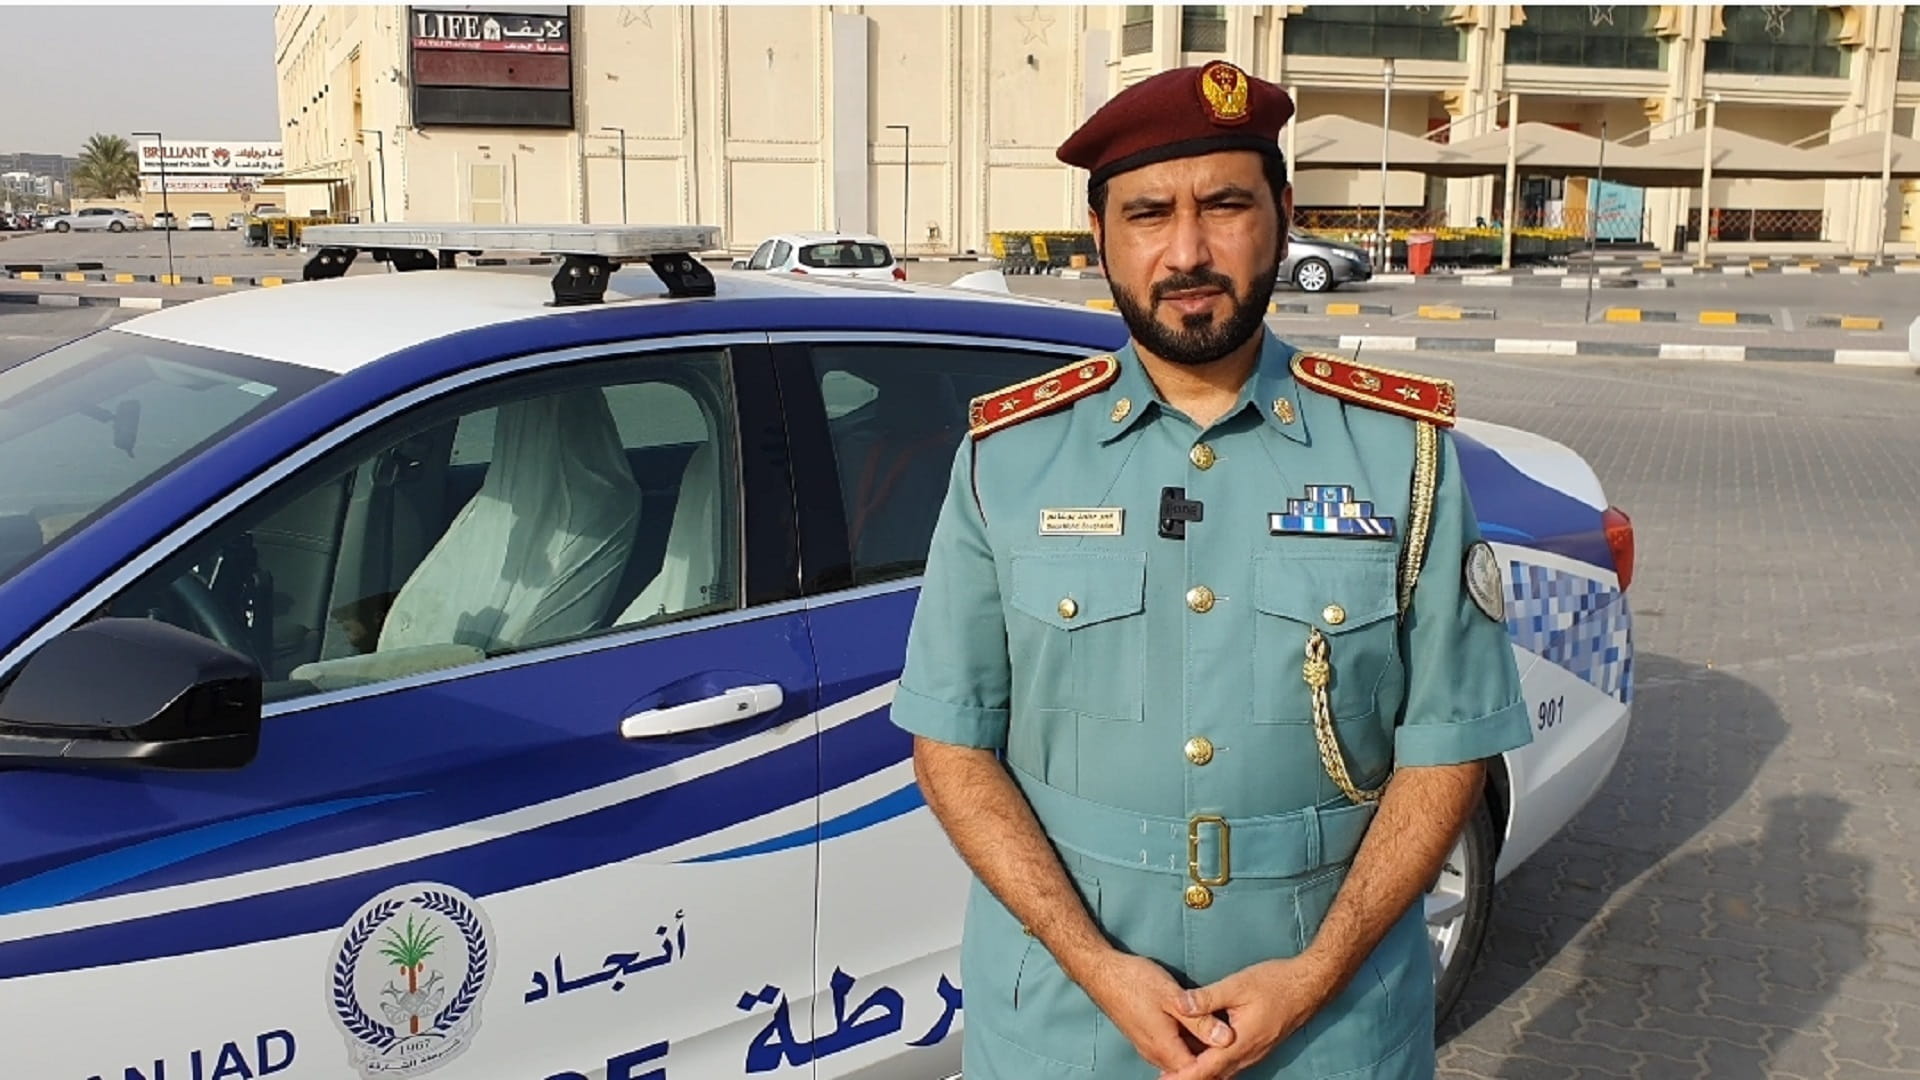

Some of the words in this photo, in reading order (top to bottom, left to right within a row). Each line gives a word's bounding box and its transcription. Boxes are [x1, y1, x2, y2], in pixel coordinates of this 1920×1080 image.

[417, 13, 481, 40] LIFE
[503, 19, 564, 42] لايف
[143, 146, 210, 159] BRILLIANT
[1538, 695, 1564, 731] 901
[524, 909, 687, 1005] أنجاد
[736, 965, 963, 1074] رطة
